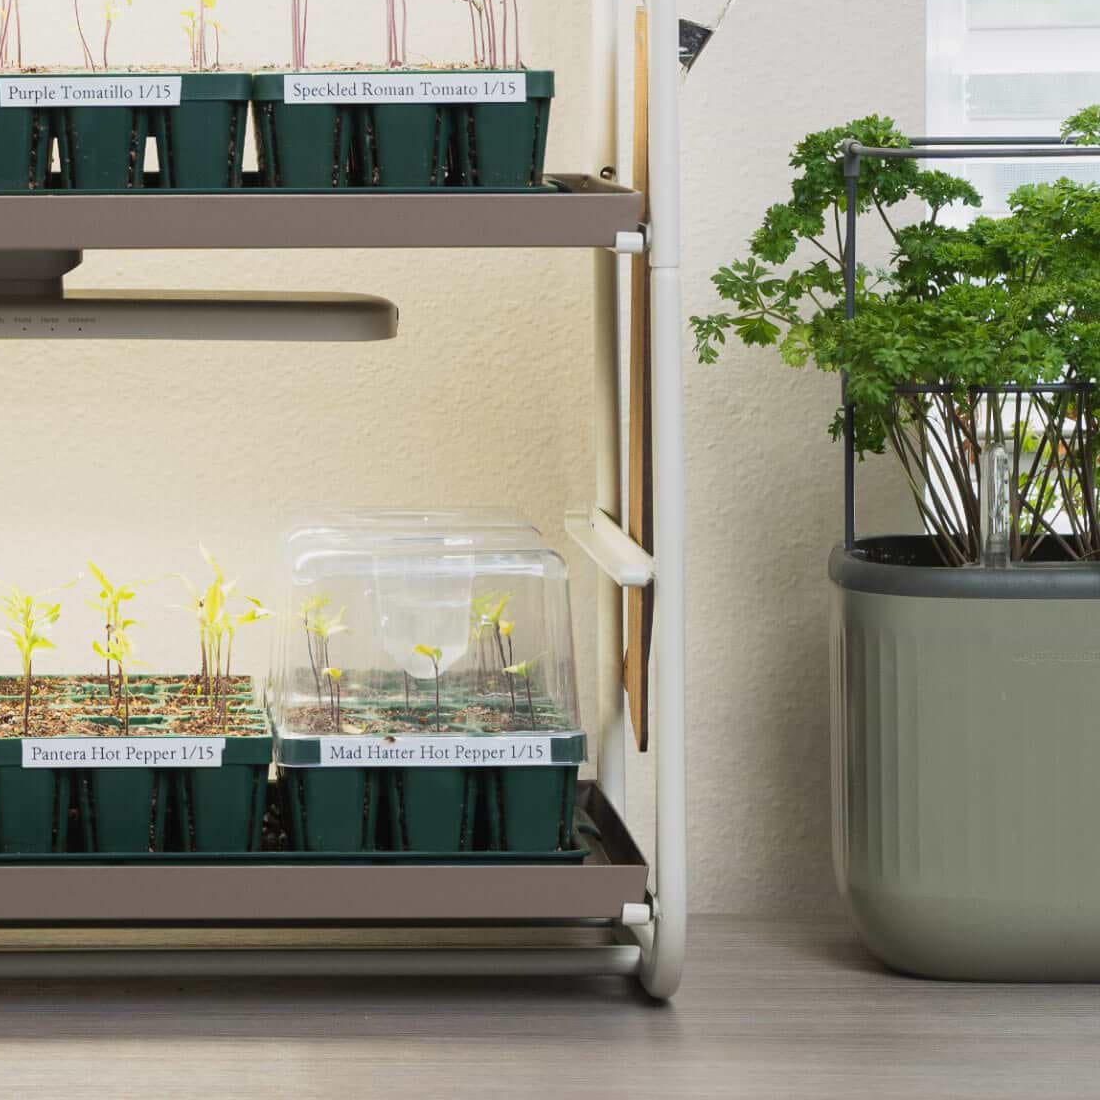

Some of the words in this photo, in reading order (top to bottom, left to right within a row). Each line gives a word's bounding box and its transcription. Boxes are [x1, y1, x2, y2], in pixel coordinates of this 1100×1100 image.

[8, 85, 56, 103] Purple
[60, 84, 132, 99] Tomatillo
[139, 84, 171, 99] 1/15
[293, 82, 357, 101] Speckled
[362, 82, 414, 96] Roman
[420, 82, 477, 96] Tomato
[483, 81, 517, 96] 1/15
[31, 746, 86, 761] Pantera
[91, 746, 120, 761] Hot
[126, 747, 177, 765] Pepper
[181, 745, 214, 760] 1/15
[330, 745, 363, 760] Mad
[367, 745, 415, 760] Hatter
[420, 745, 450, 760] Hot
[455, 745, 506, 763] Pepper
[511, 744, 544, 759] 1/15
